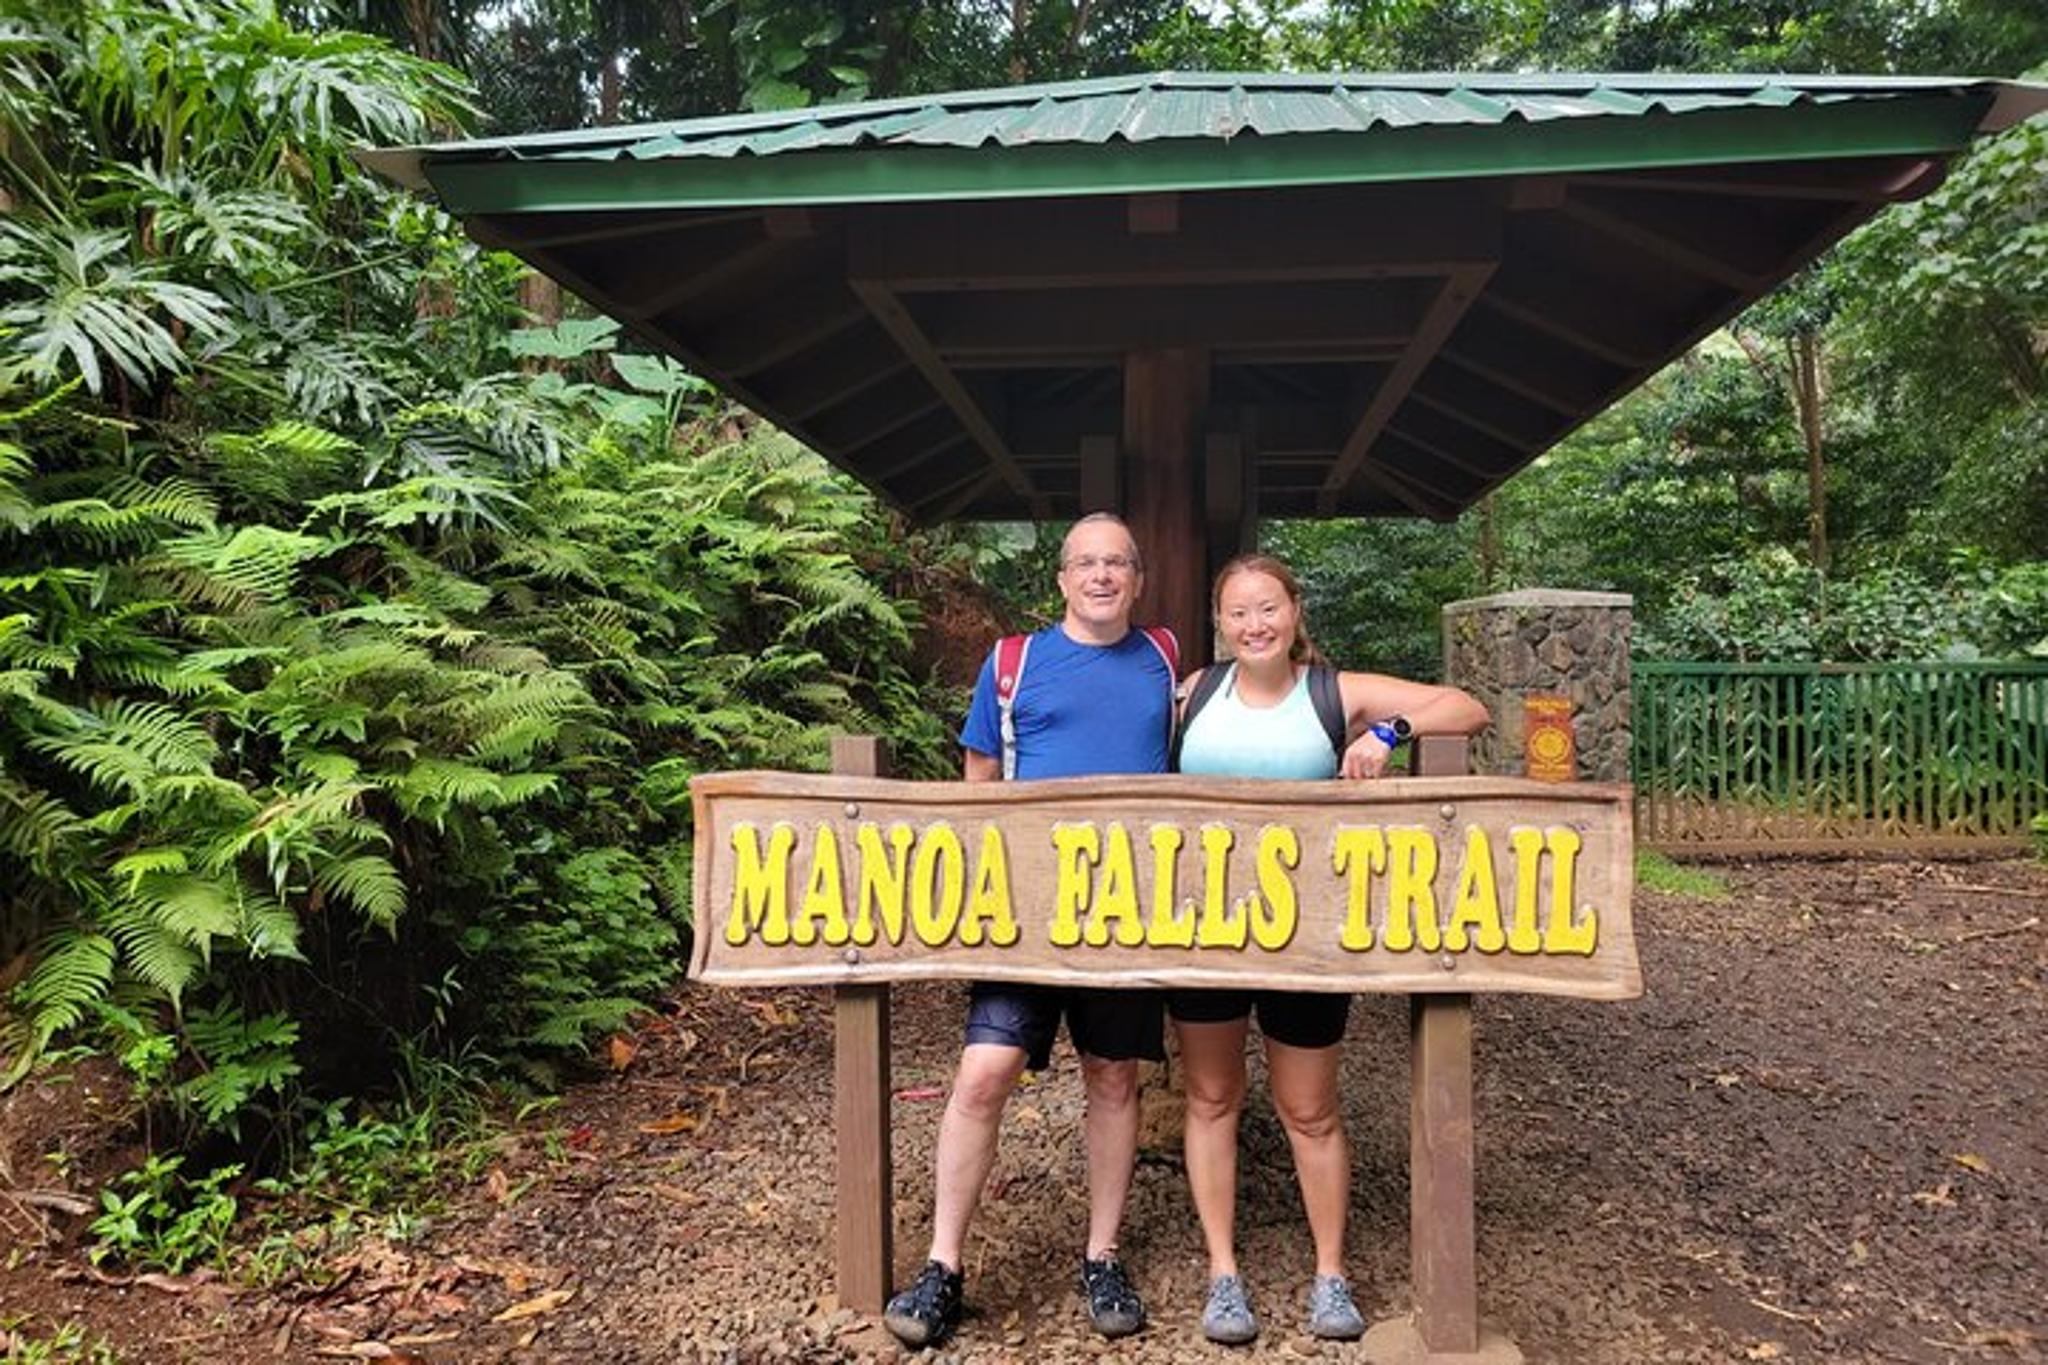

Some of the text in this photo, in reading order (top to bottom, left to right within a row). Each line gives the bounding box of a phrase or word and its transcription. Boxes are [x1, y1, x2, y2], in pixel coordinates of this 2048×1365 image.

[725, 821, 1597, 955] MANOA FALLS TRAIL
